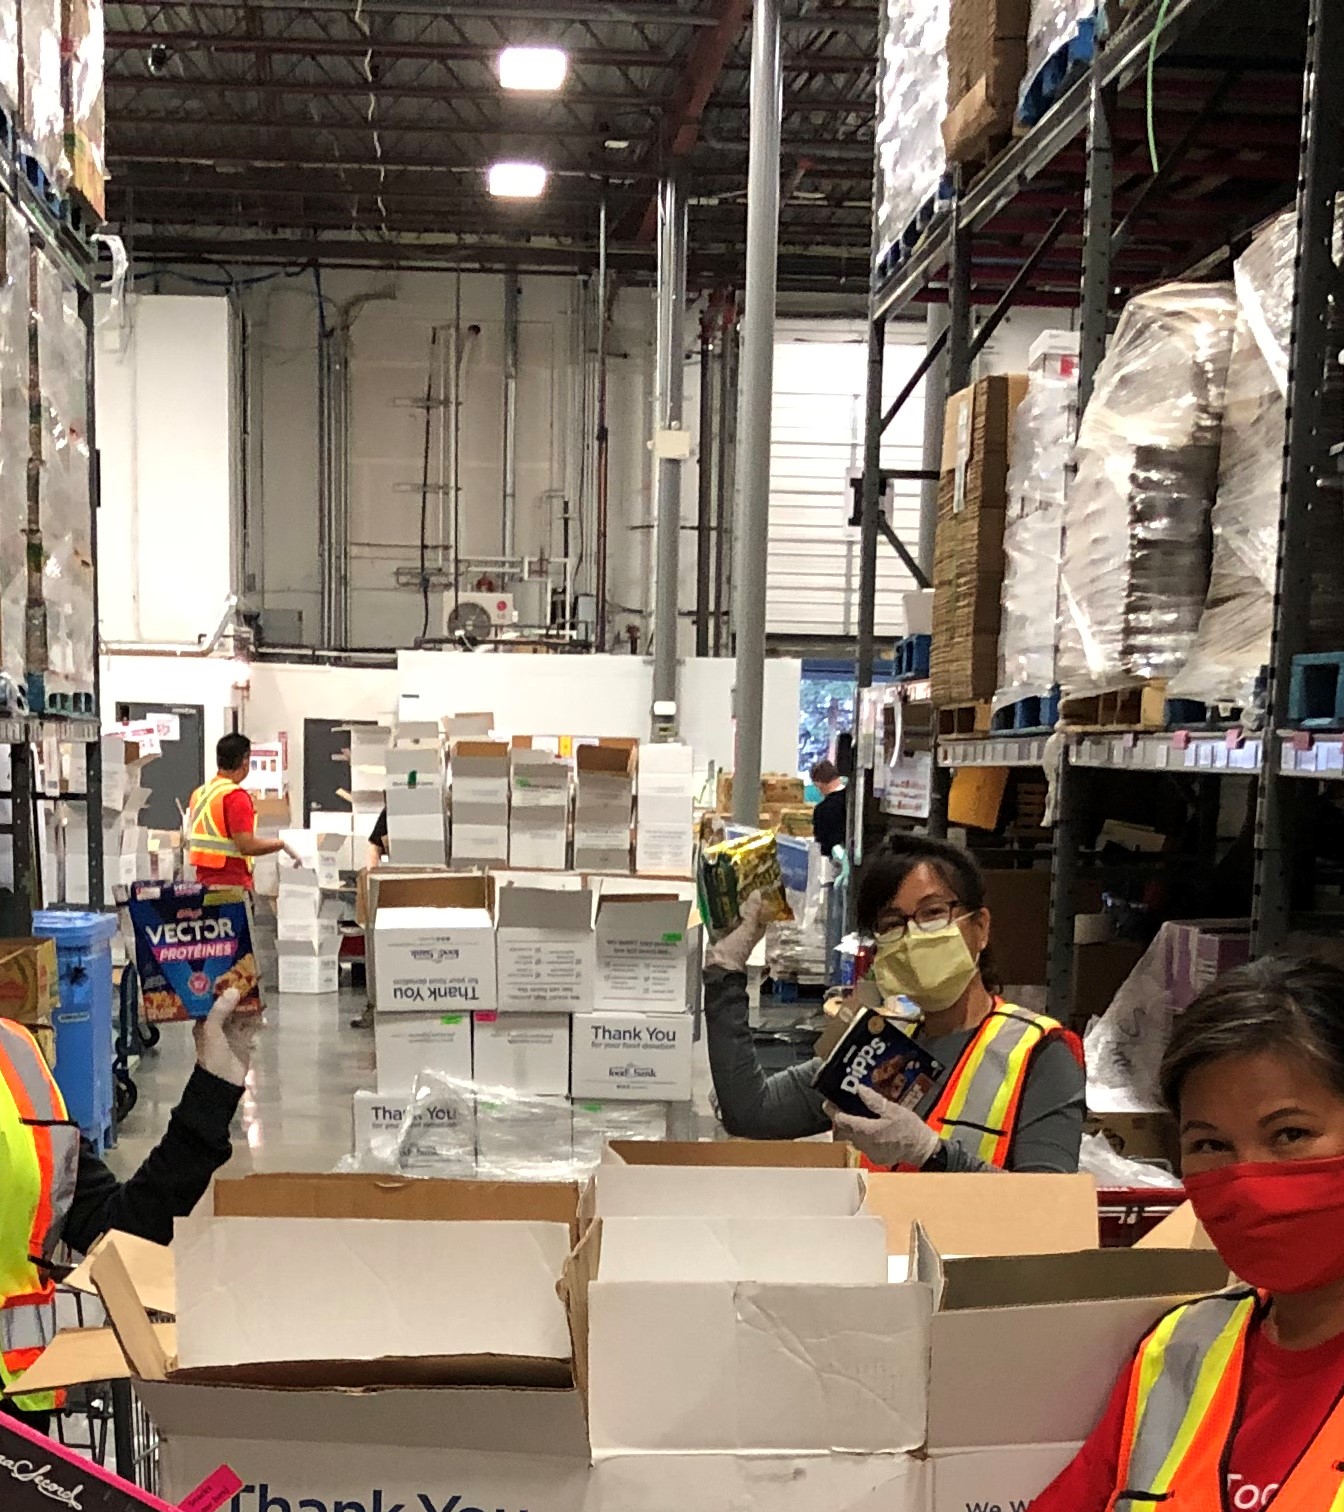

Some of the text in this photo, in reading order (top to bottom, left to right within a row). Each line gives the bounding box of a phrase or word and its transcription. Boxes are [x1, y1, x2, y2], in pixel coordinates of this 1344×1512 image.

[145, 917, 235, 944] VECTOR
[394, 986, 479, 1001] Thank You
[591, 1025, 676, 1041] Thank You
[427, 1106, 456, 1120] You
[11, 1460, 84, 1511] Secord
